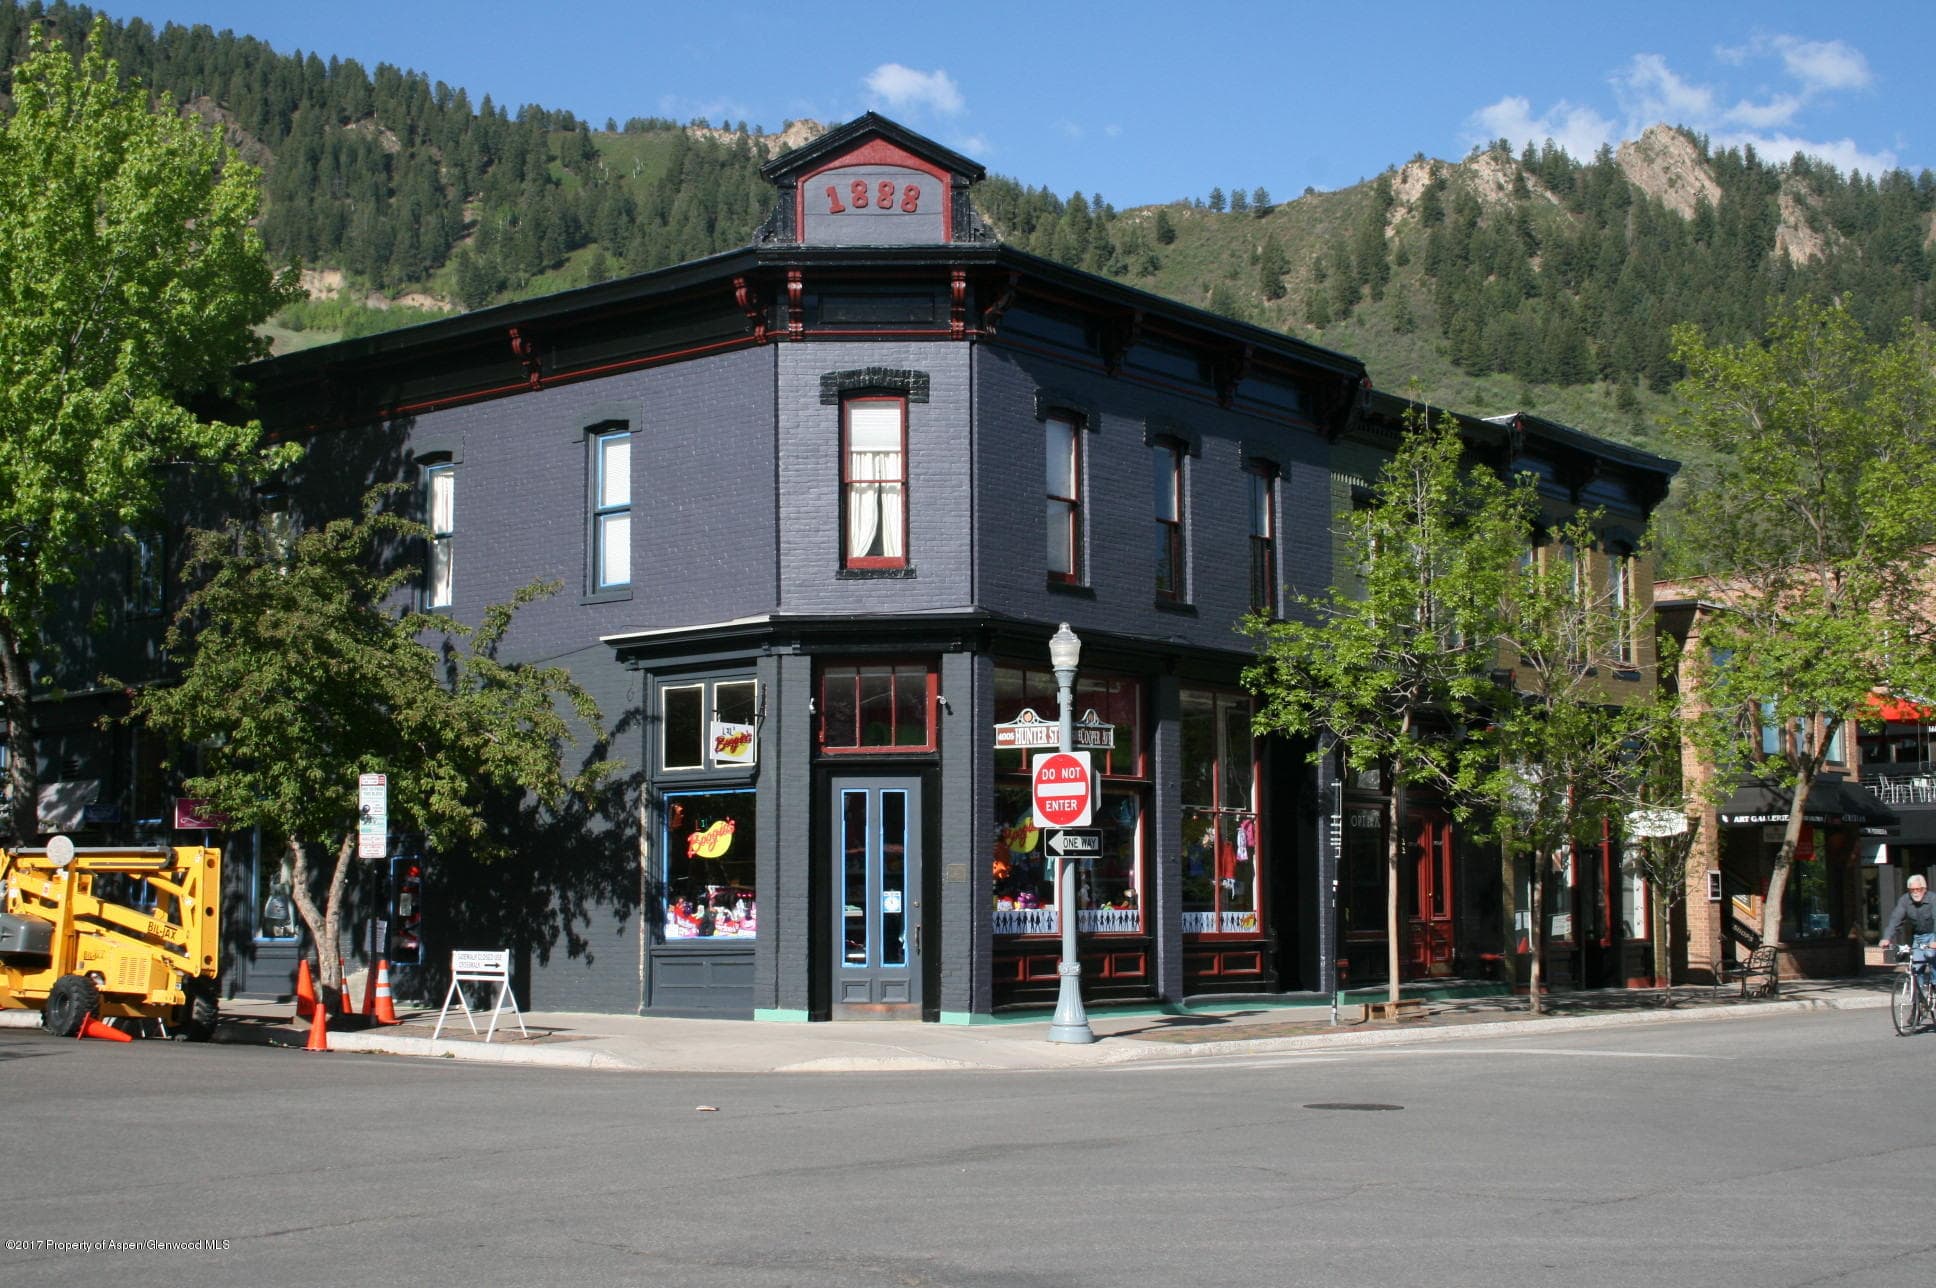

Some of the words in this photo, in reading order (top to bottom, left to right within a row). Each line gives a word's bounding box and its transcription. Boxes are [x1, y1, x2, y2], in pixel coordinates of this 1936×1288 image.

[825, 180, 920, 214] 1888
[1015, 727, 1047, 745] HUNTER
[1049, 726, 1059, 744] ST
[1081, 728, 1101, 745] COOPER
[1042, 768, 1056, 780] DO
[1061, 767, 1080, 779] NOT
[1045, 799, 1078, 812] ENTER
[1733, 815, 1750, 823] ART
[1062, 837, 1078, 848] ONE
[1080, 836, 1097, 848] WAY
[147, 921, 177, 940] BIL-JAX
